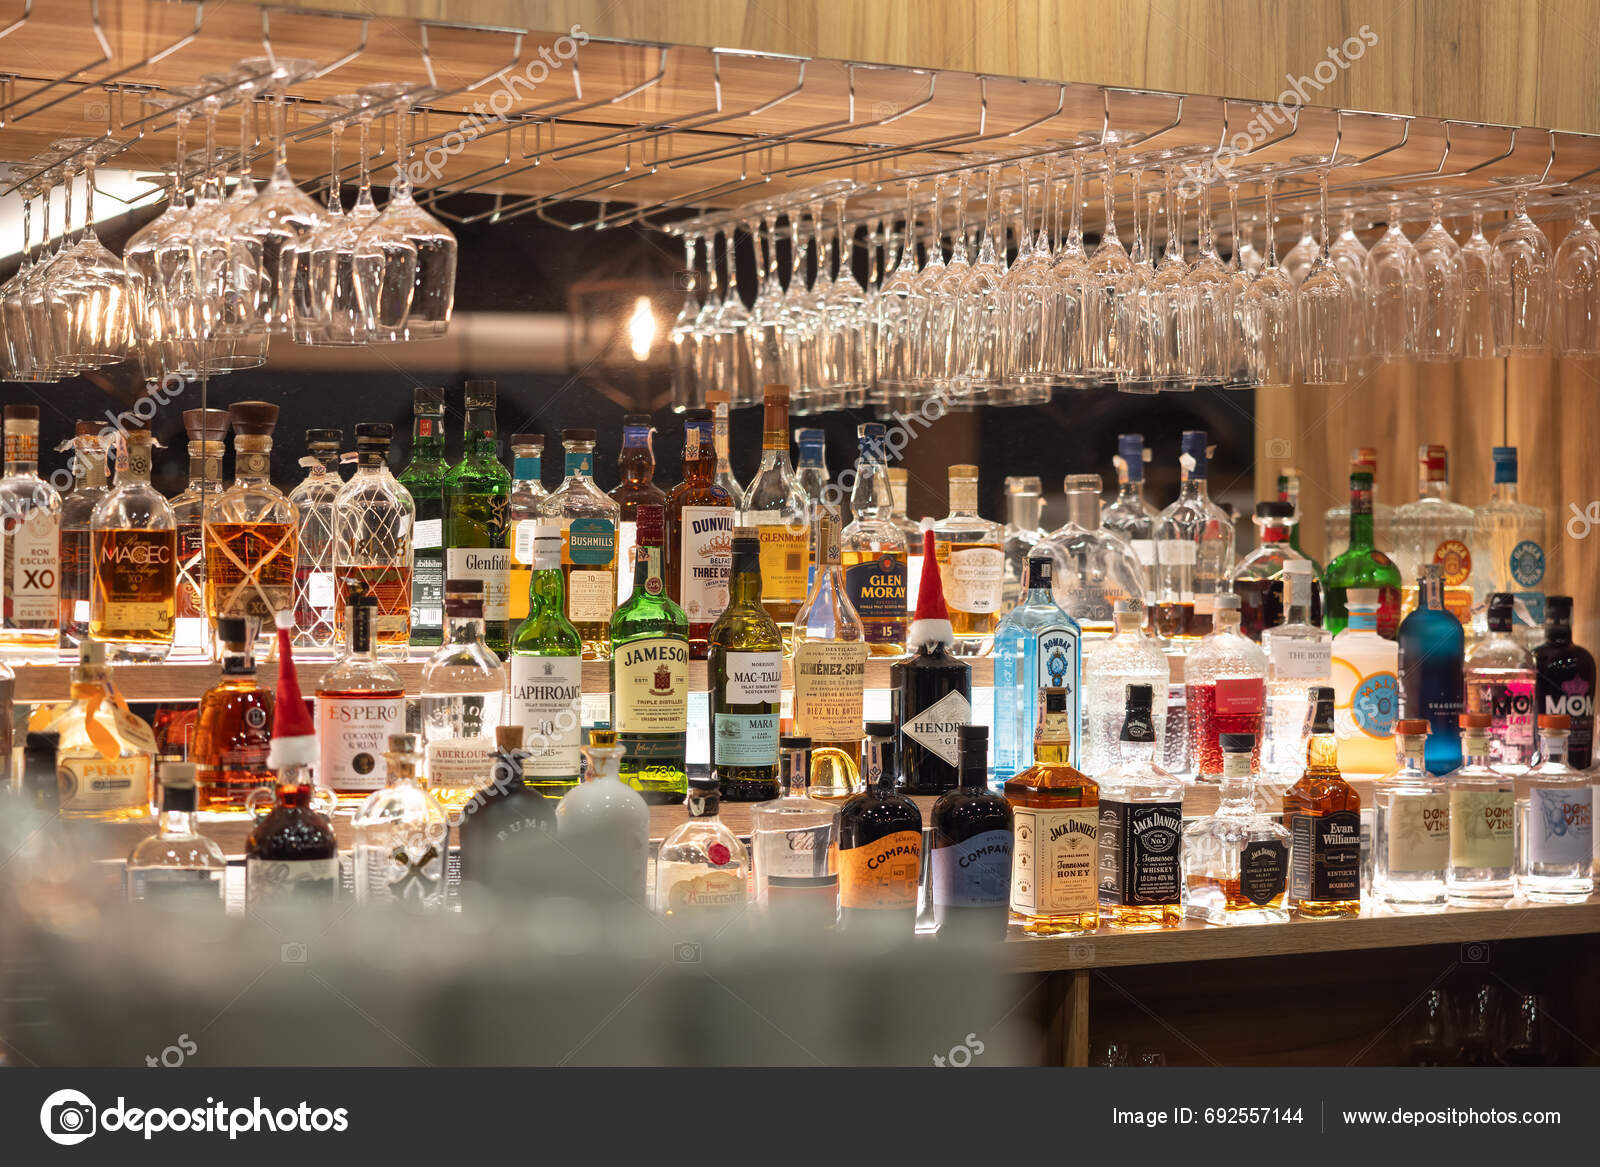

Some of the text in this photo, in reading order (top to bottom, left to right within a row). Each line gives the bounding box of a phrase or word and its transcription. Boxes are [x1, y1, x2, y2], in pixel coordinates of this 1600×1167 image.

[571, 535, 614, 547] BUSHMILLS
[31, 548, 49, 556] RON
[102, 545, 170, 564] MAGEC
[20, 557, 57, 565] ESCLAVO
[692, 567, 718, 578] THREE
[23, 569, 55, 589] XO
[869, 575, 902, 586] GLEN
[861, 586, 906, 598] MORAY
[882, 625, 893, 637] 15
[1043, 638, 1072, 651] BOMBAY
[624, 646, 688, 667] JAMESON
[1289, 651, 1304, 659] THE
[329, 705, 398, 723] ESPERO
[749, 719, 773, 729] MARA
[343, 732, 384, 741] COCONUT
[944, 737, 957, 745] GI
[357, 741, 378, 749] RUM
[435, 750, 487, 759] ABERLOUR
[83, 764, 137, 777] PYRAT
[432, 771, 442, 782] 12
[1133, 811, 1182, 836] JACK DANIEL'S
[1330, 823, 1354, 834] Evan
[1050, 822, 1069, 842] JACK
[1069, 818, 1097, 841] DANIEL'S
[1322, 834, 1360, 845] Williams
[1142, 853, 1174, 863] Tennessee
[1057, 860, 1090, 870] Tennessee
[1057, 869, 1090, 878] HONEY
